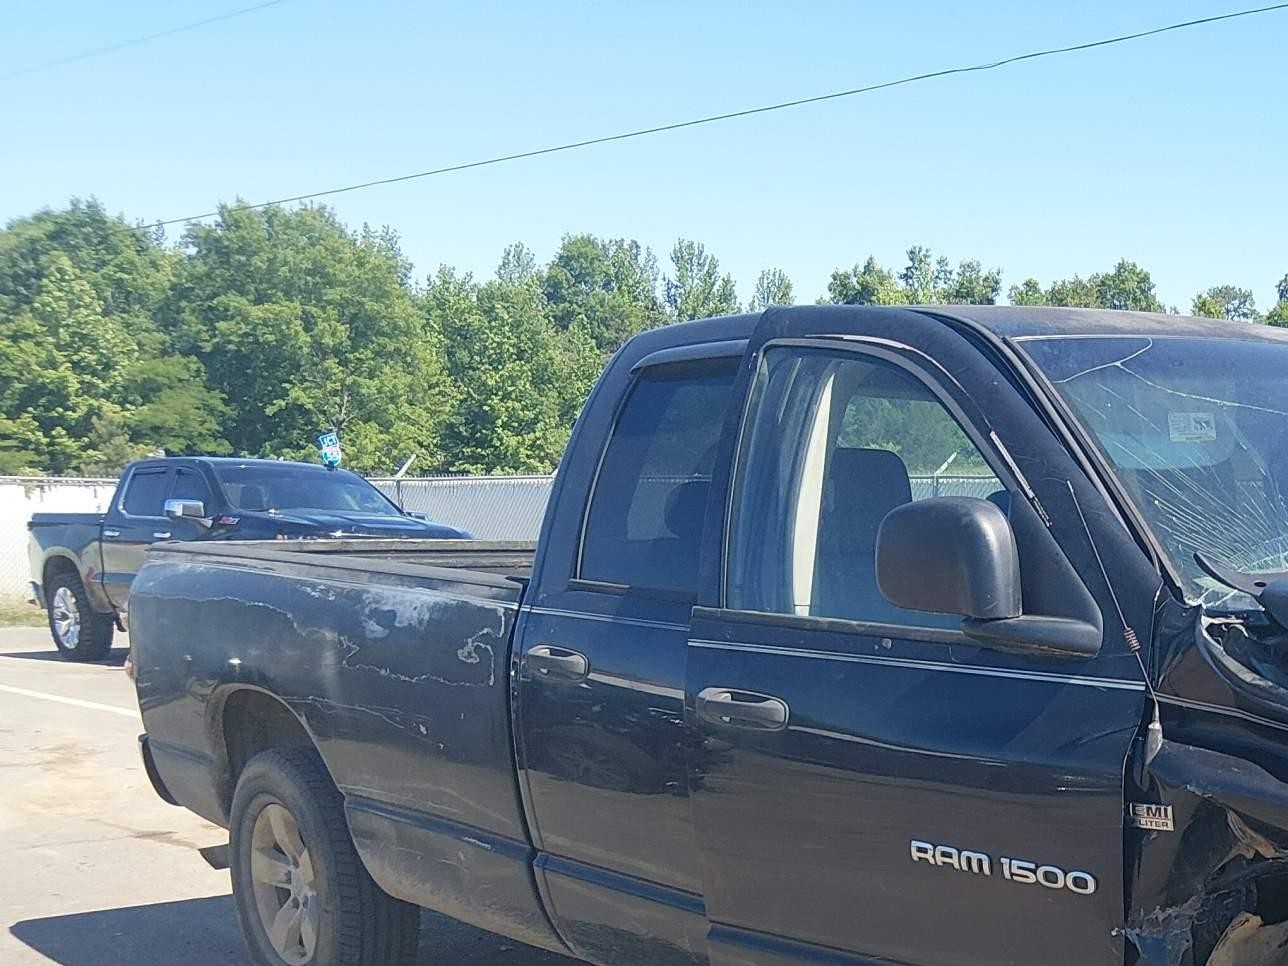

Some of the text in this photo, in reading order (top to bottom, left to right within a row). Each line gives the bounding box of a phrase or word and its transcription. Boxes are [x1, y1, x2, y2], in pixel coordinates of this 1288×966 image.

[322, 435, 337, 446] JCT
[1129, 804, 1169, 819] EMI
[1138, 819, 1169, 829] LITER
[910, 840, 1098, 895] RAM 1500
